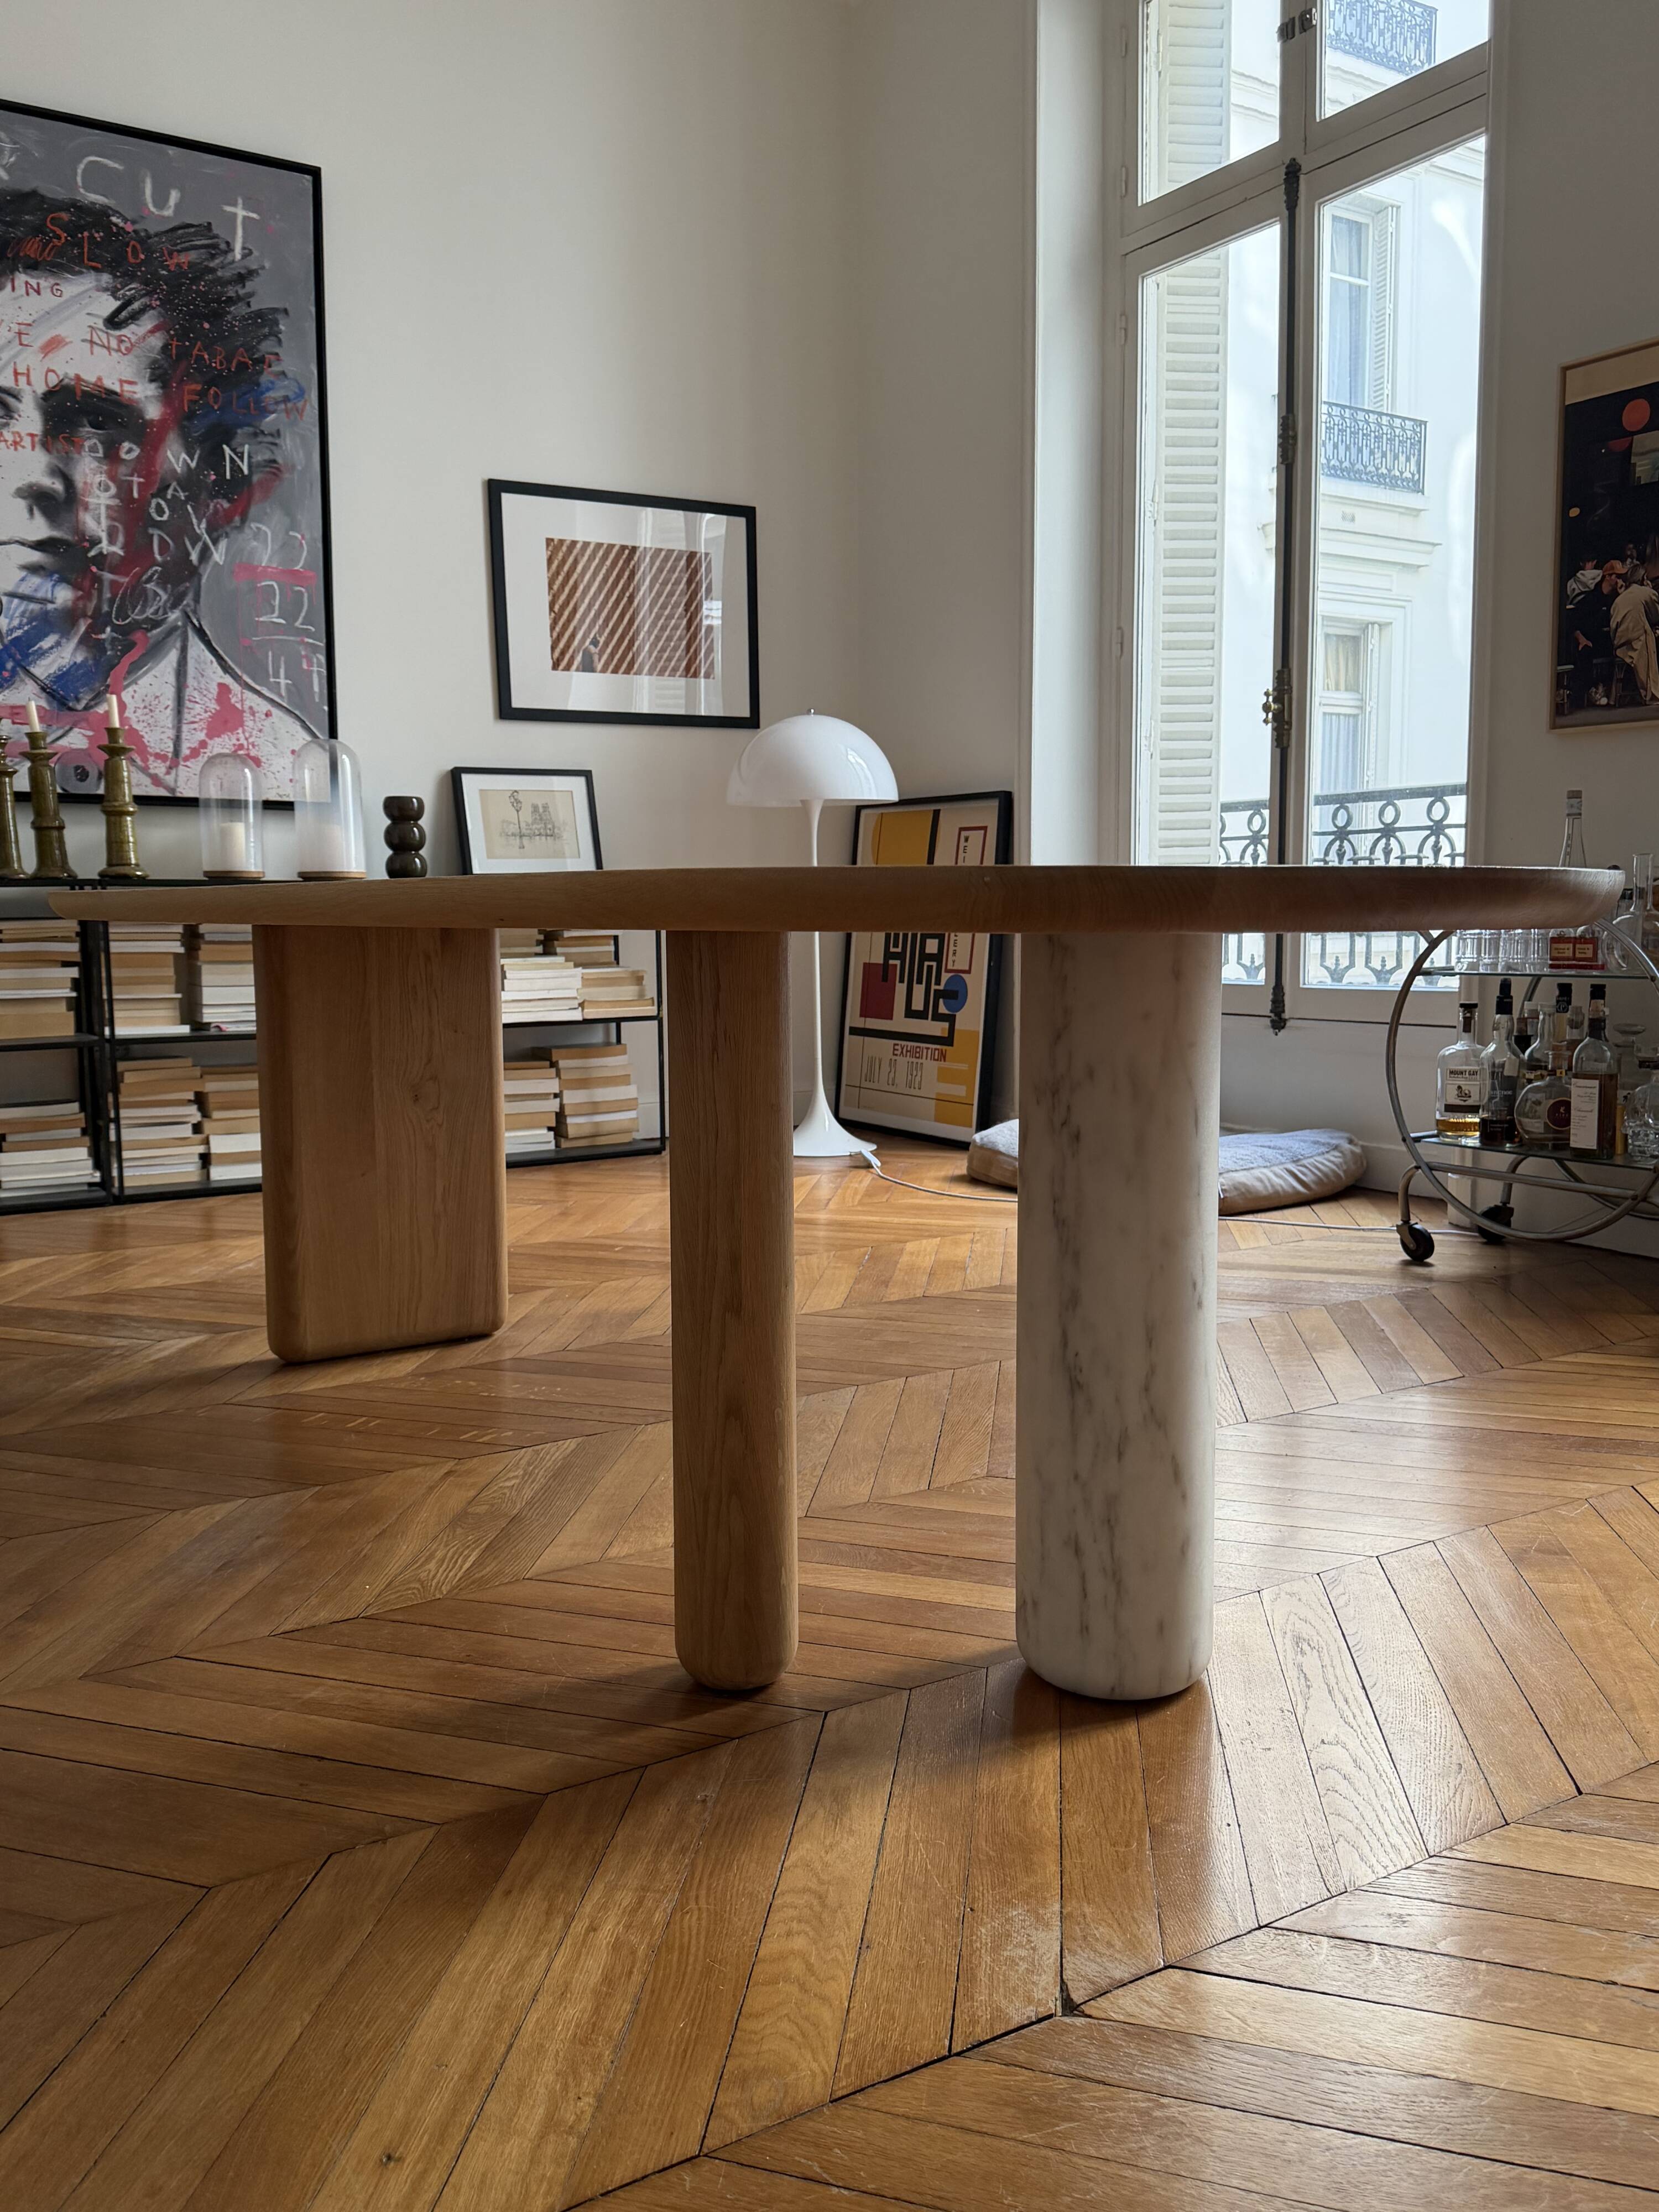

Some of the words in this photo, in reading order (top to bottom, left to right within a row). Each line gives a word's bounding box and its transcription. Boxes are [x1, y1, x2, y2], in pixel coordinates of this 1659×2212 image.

[76, 155, 260, 262] CUT
[46, 212, 190, 272] SLOW
[13, 361, 139, 405] HOME
[864, 1055, 883, 1084] JULY
[905, 1060, 924, 1091] 1923
[893, 1043, 947, 1062] EXHIBITION
